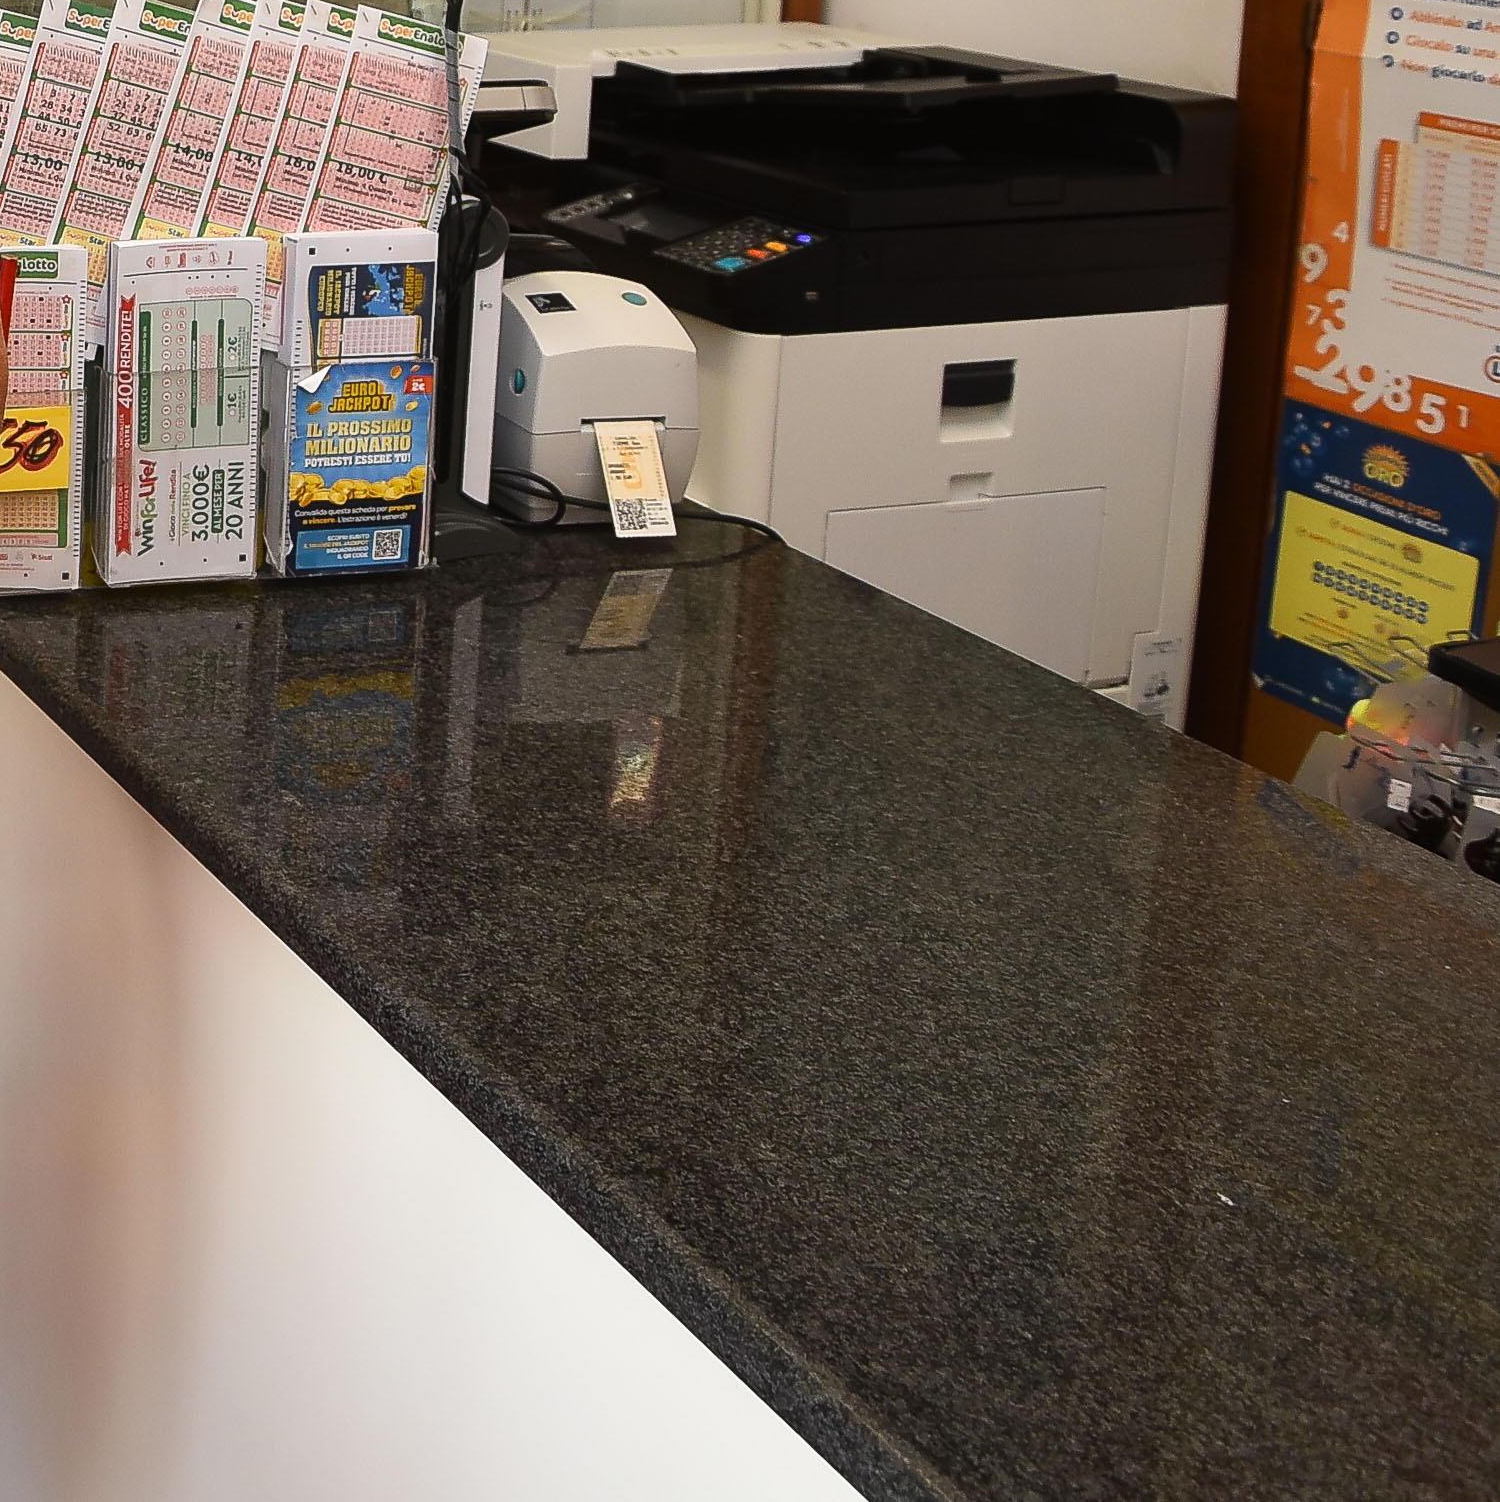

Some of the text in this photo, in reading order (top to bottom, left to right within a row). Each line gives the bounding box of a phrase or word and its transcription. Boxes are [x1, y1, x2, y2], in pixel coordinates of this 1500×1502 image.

[118, 309, 133, 370] RENDITE!
[116, 370, 133, 410] 400
[328, 394, 393, 414] JACKPOT
[342, 380, 379, 398] EURO
[138, 386, 149, 442] CLASSICO
[305, 417, 413, 439] IL PROSSIMO
[304, 435, 412, 457] MILIONARIO
[304, 452, 412, 469] POTRESTI ESSERE TU!
[191, 463, 210, 542] 3.000€
[225, 460, 245, 541] 20 ANNI
